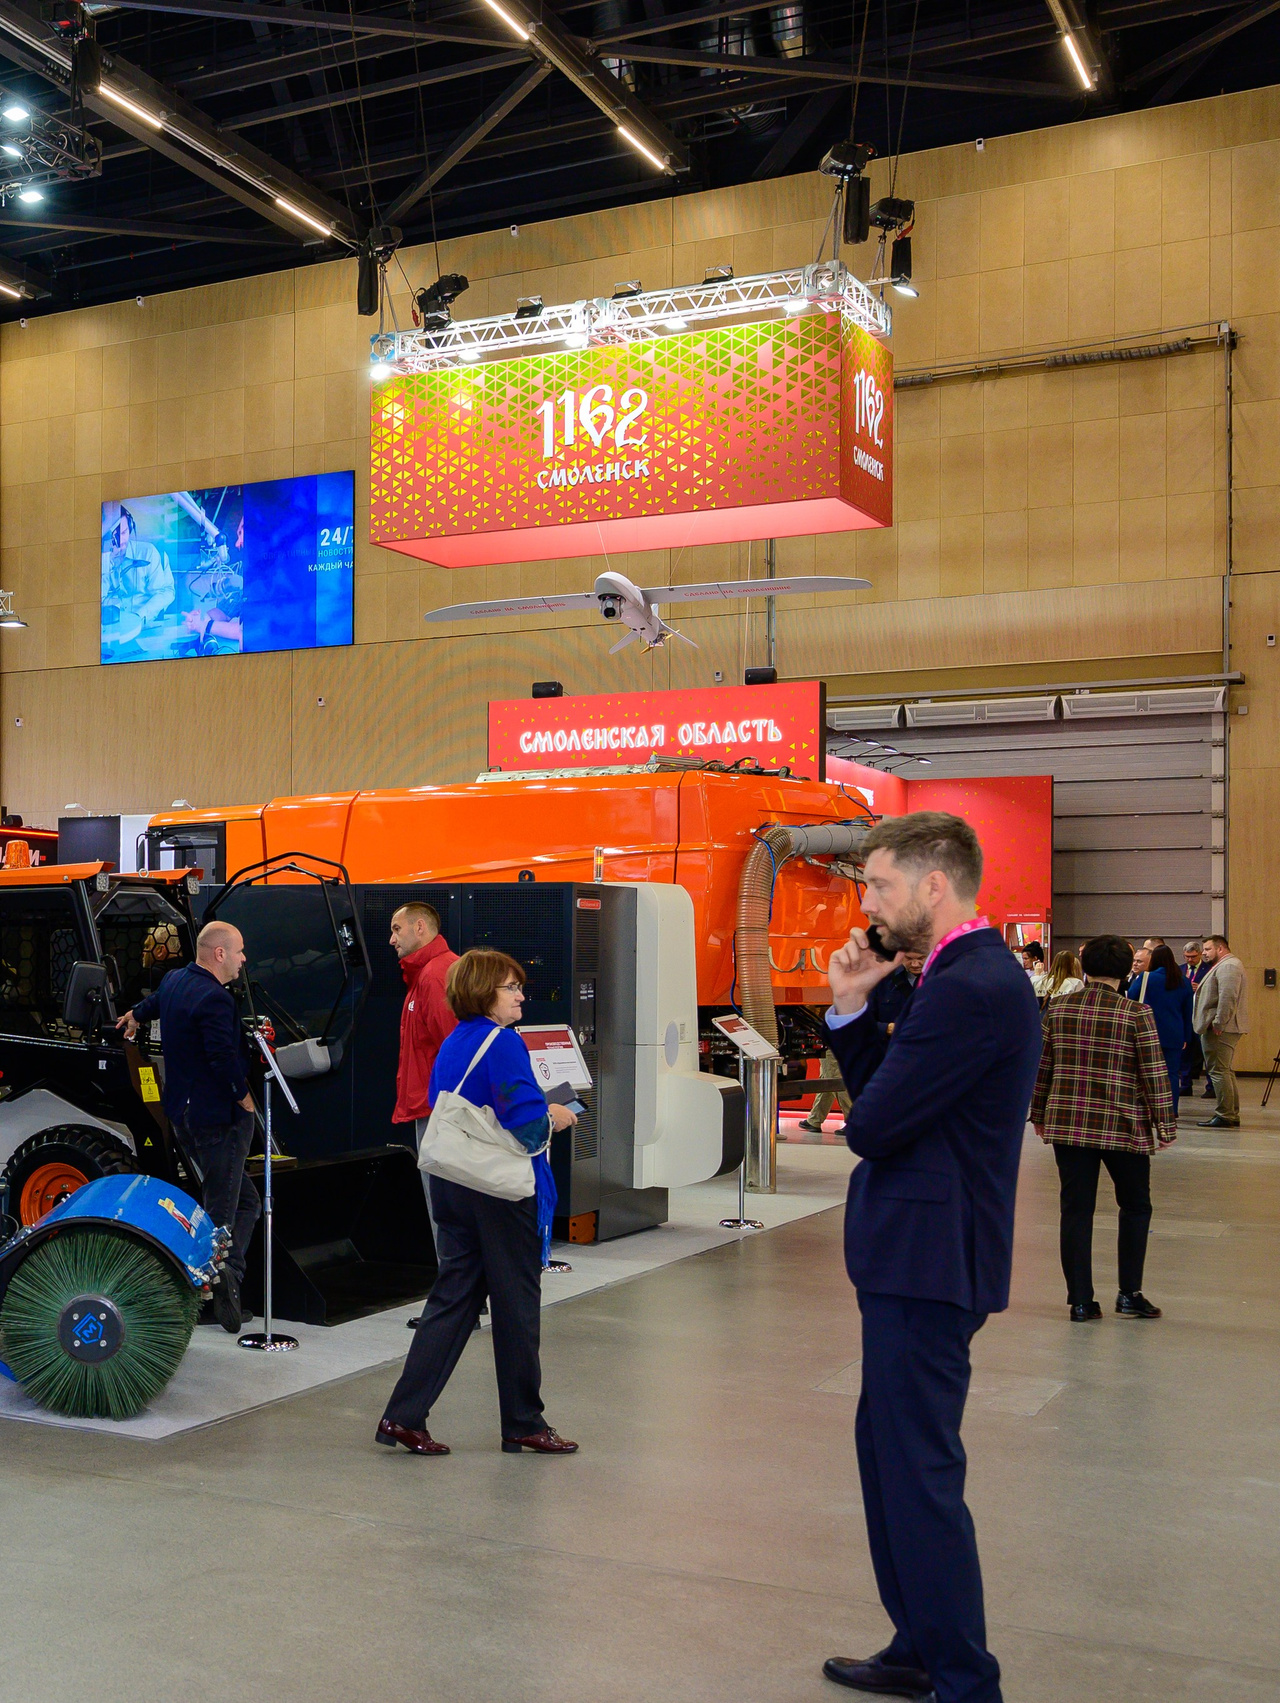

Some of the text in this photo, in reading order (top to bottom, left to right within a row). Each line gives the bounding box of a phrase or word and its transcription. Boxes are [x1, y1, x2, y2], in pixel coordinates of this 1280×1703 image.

[536, 384, 648, 458] 1162
[853, 368, 884, 450] 1162
[537, 458, 650, 489] СМОЛЕНСК
[853, 445, 884, 481] СМОЛЕНСК
[308, 560, 343, 572] КАЖДЫЙ
[519, 719, 783, 754] СМОЛЕНСКАЯ ОБЛАСТЬ
